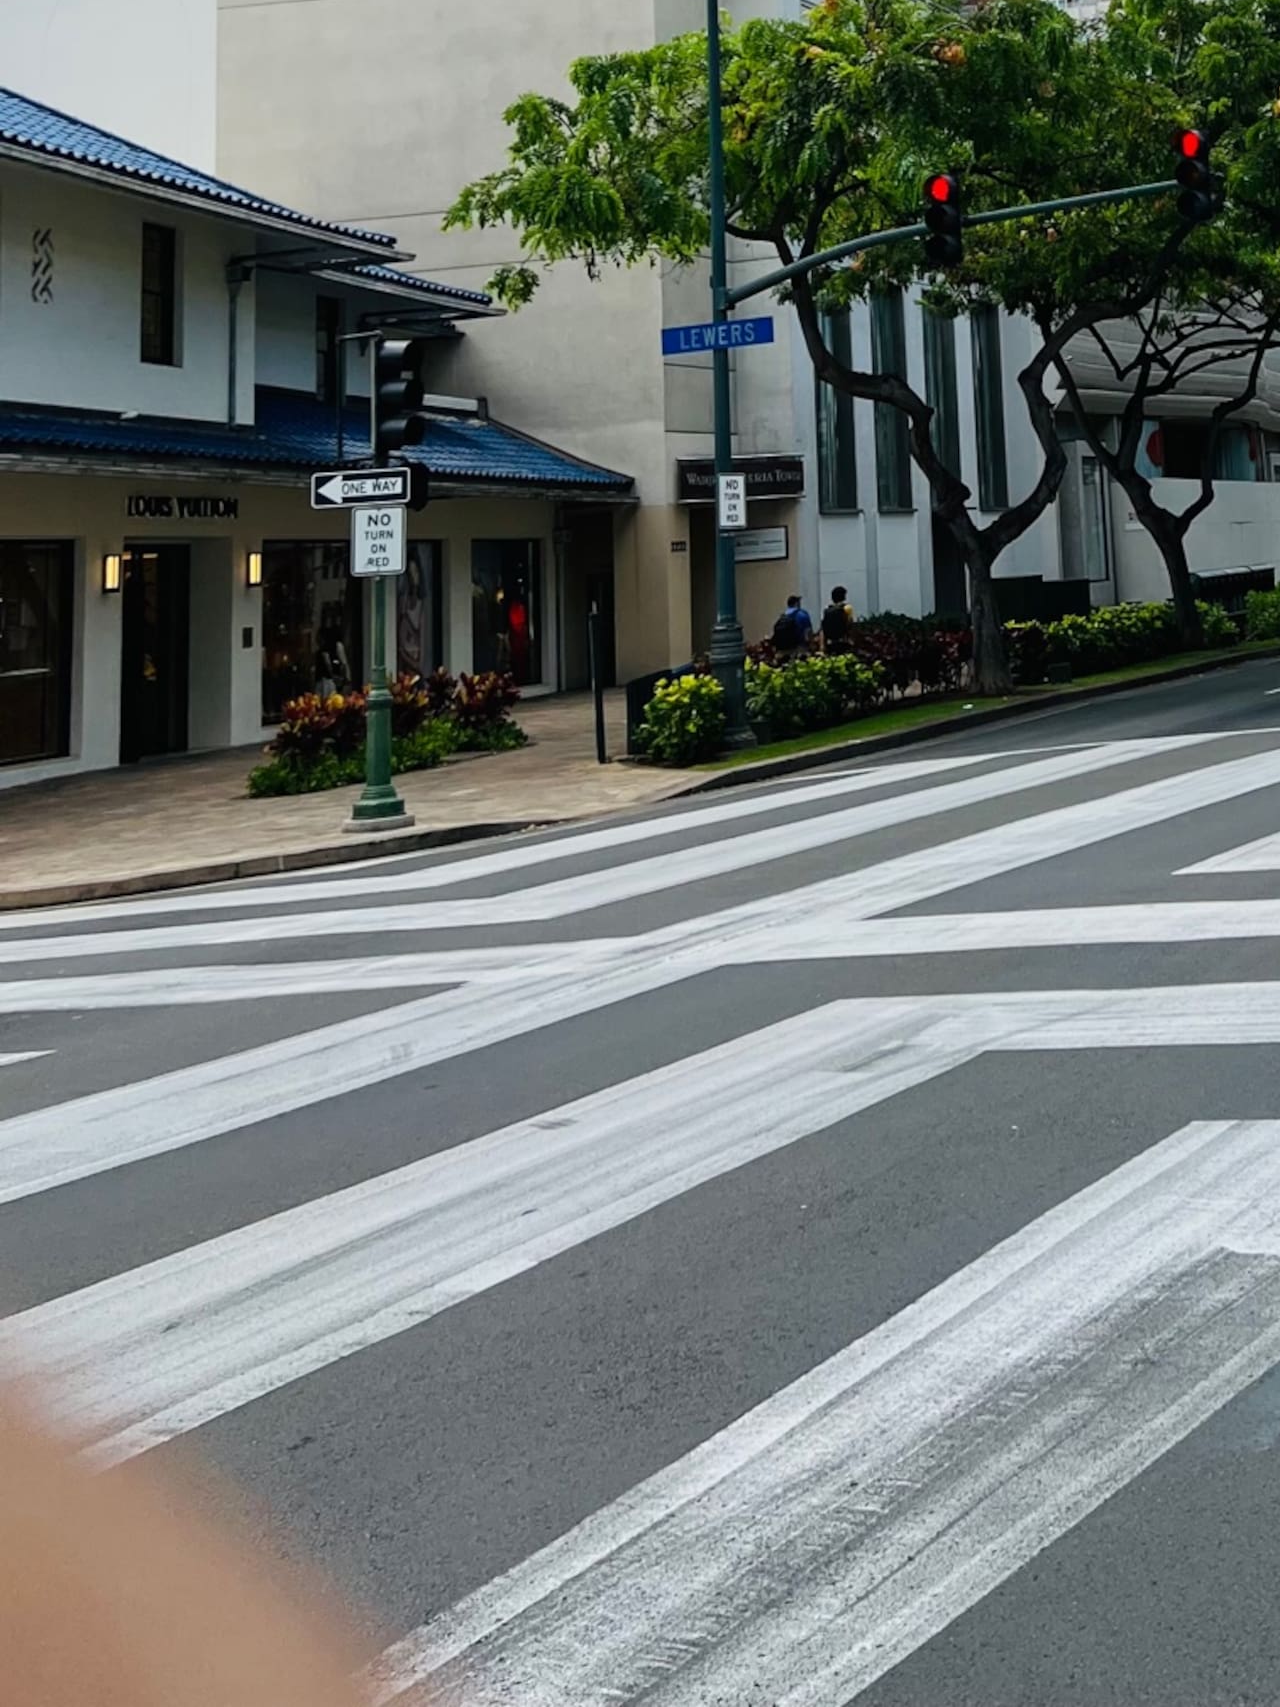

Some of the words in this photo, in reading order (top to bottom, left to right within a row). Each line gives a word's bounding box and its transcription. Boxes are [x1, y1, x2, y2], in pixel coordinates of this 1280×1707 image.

[680, 323, 754, 350] LEWERS
[341, 482, 368, 495] ONE
[372, 480, 398, 492] WAY
[726, 479, 739, 490] NO
[127, 495, 172, 516] LOUIS
[176, 497, 238, 518] VUITTON
[367, 514, 391, 527] NO
[365, 530, 394, 540] TURN
[370, 544, 387, 554] ON
[367, 557, 390, 566] RED
